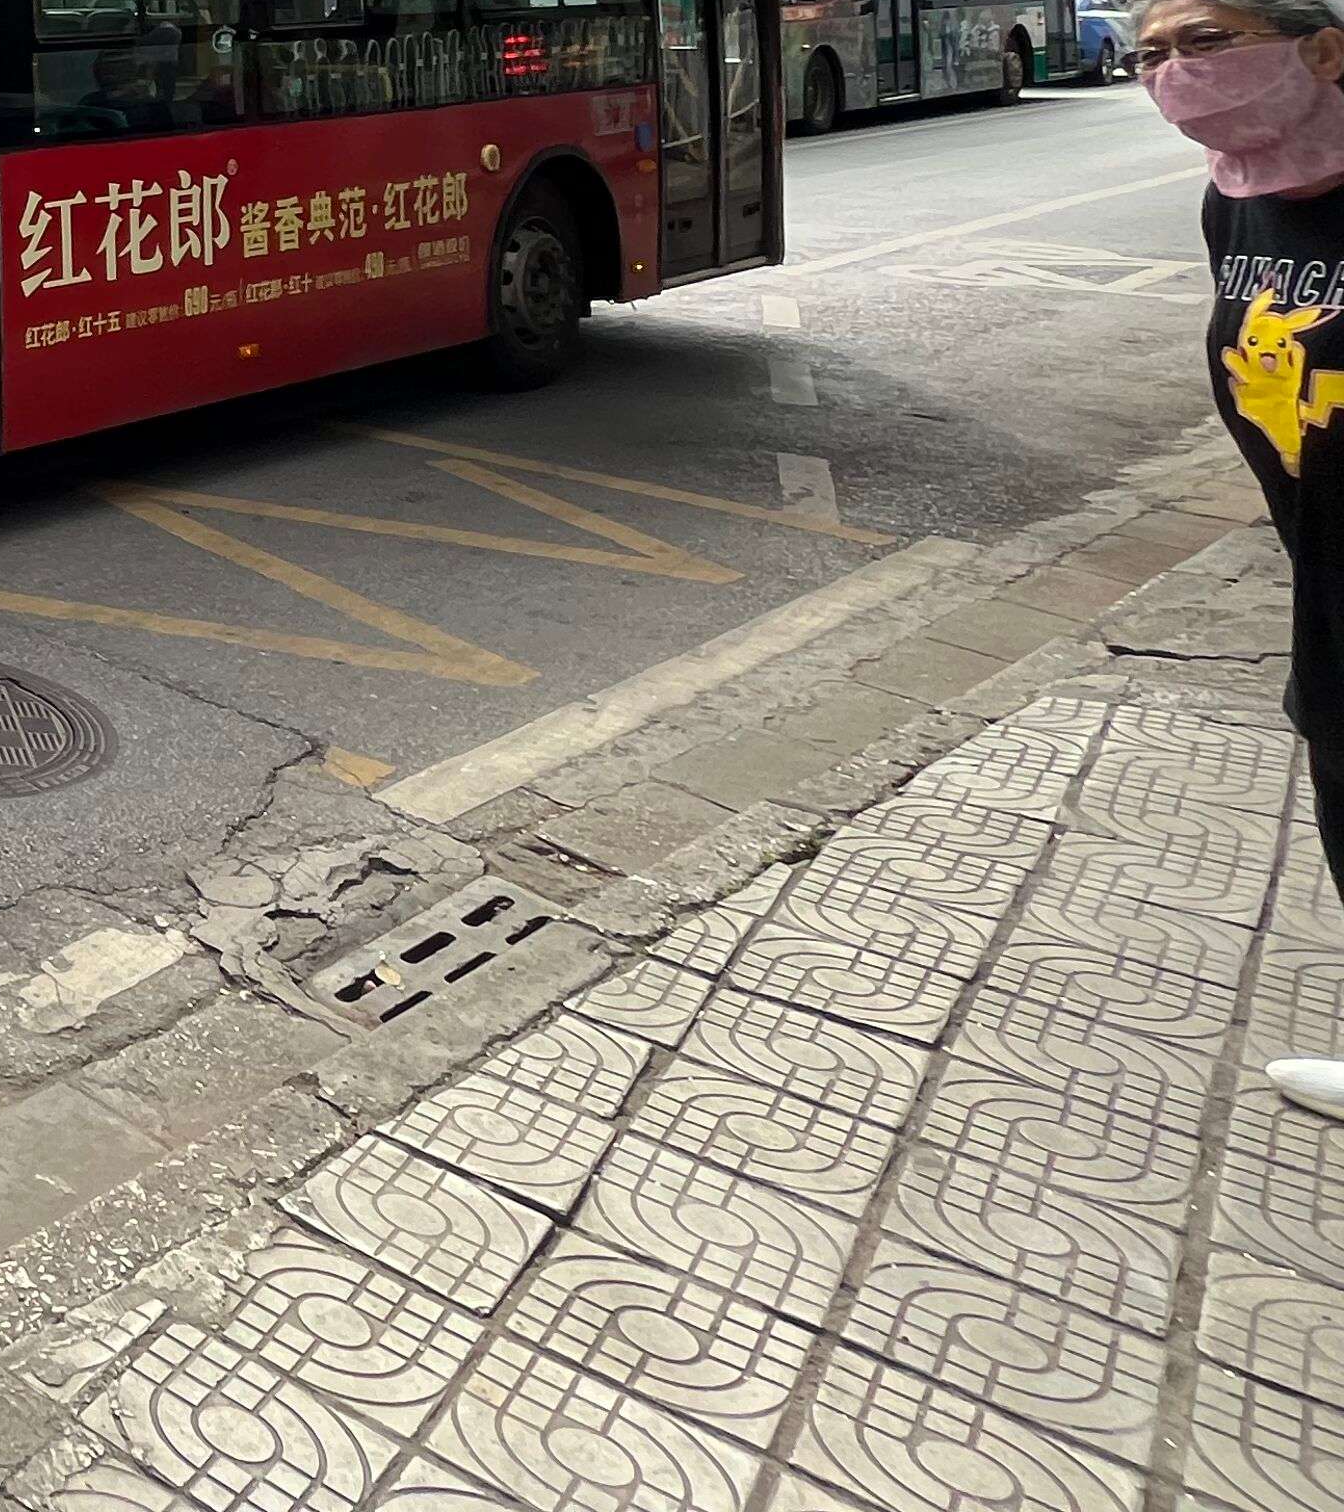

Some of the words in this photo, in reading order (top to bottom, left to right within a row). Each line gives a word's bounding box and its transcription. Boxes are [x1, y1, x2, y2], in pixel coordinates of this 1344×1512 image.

[17, 169, 231, 298] 红花郎
[239, 170, 470, 259] 酱香典范·红花郎
